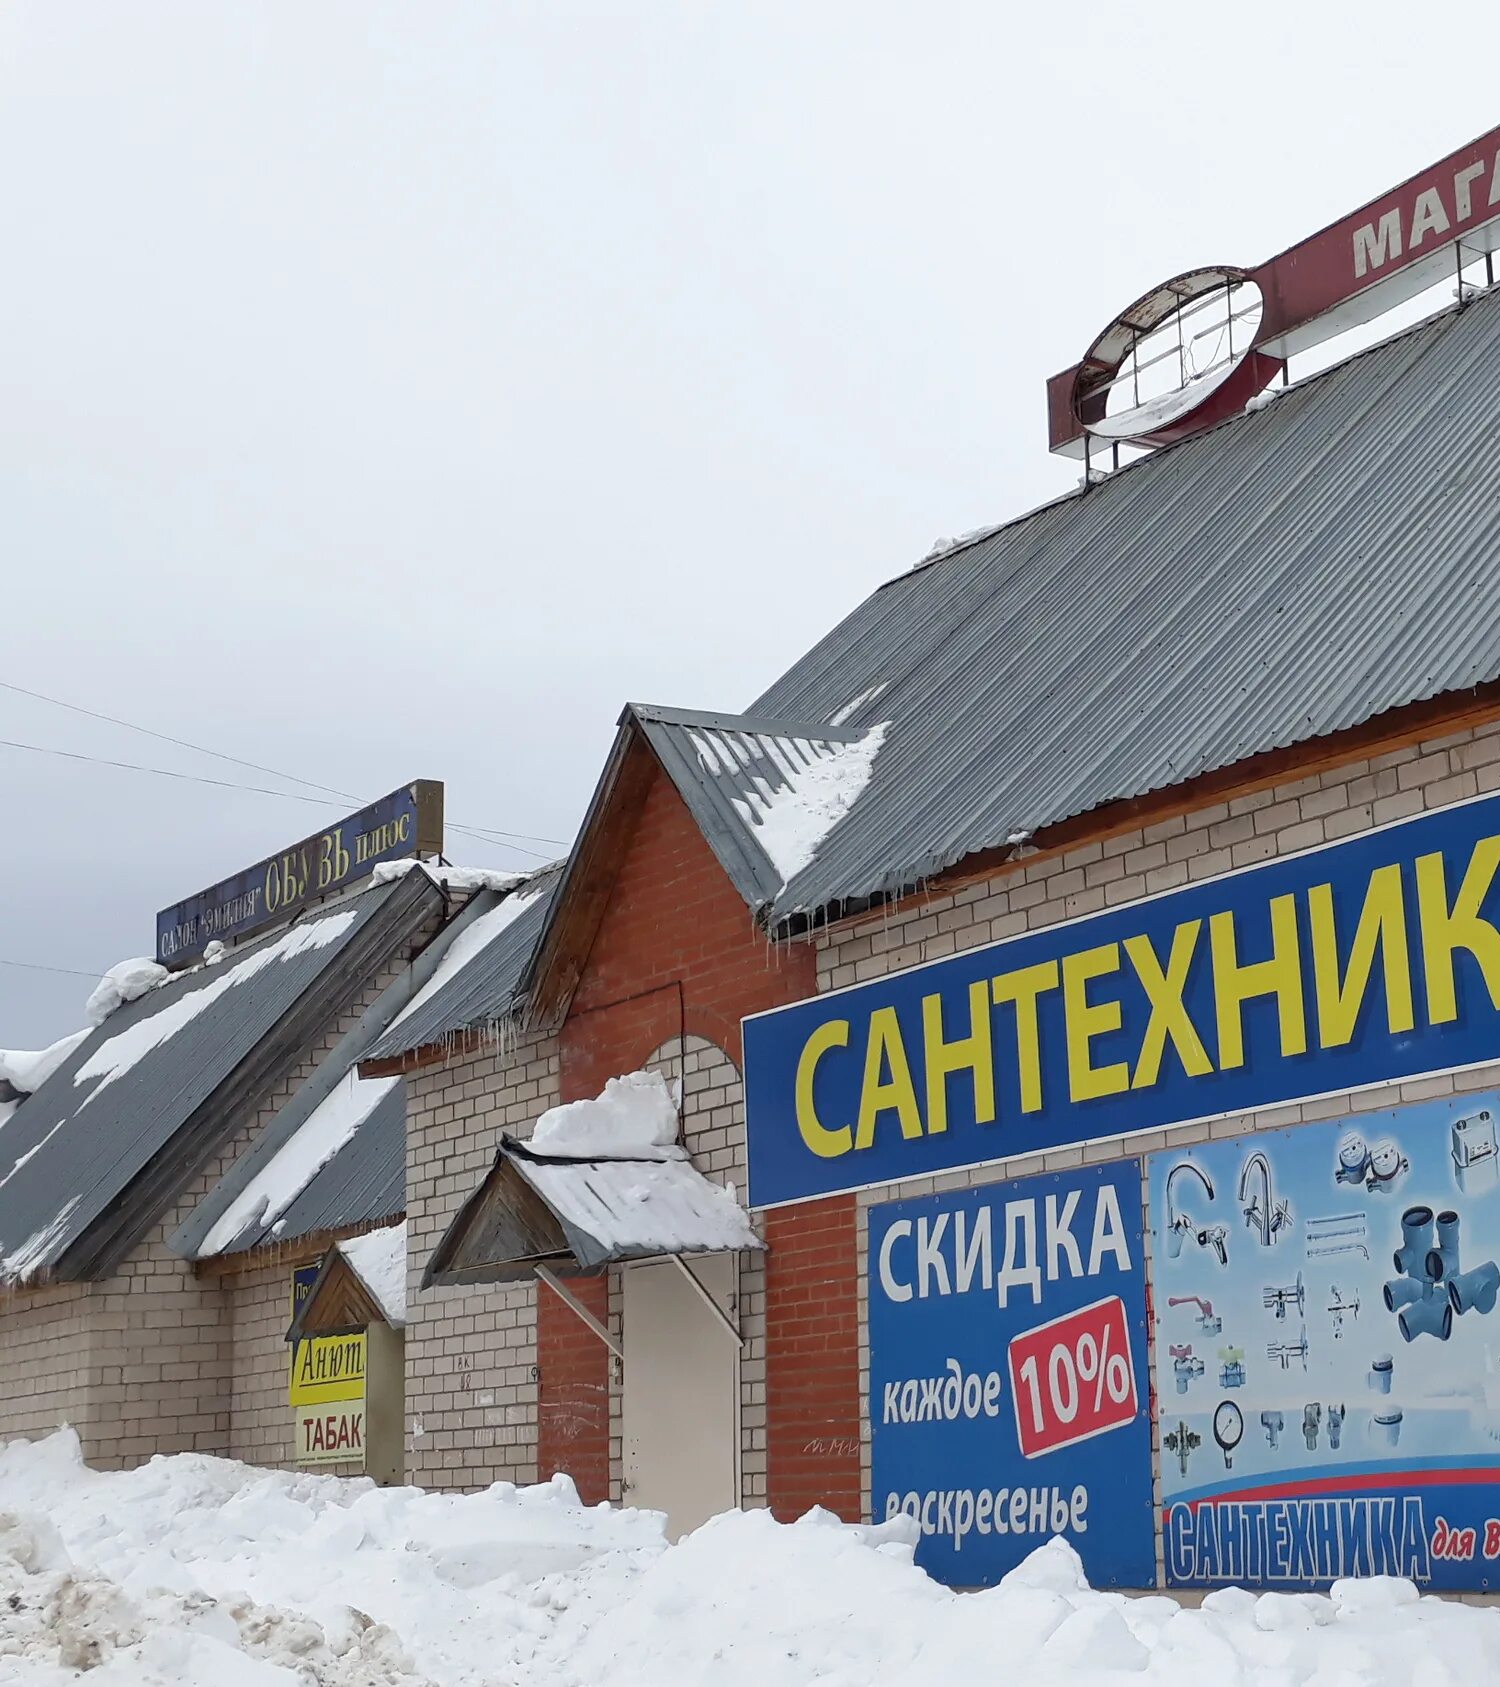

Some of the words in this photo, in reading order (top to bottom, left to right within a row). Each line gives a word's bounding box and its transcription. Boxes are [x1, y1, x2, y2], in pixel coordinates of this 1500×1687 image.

[264, 828, 350, 913] ОБУВЬ
[878, 1184, 1132, 1308] СКИДКА
[300, 1340, 365, 1382] Анют
[883, 1357, 1001, 1424] каждое
[1019, 1323, 1131, 1434] 10%
[303, 1413, 363, 1452] ТАБАК
[885, 1484, 1089, 1551] воскресенье
[1169, 1496, 1432, 1581] САНТЕХНИКА
[1431, 1517, 1477, 1558] для
